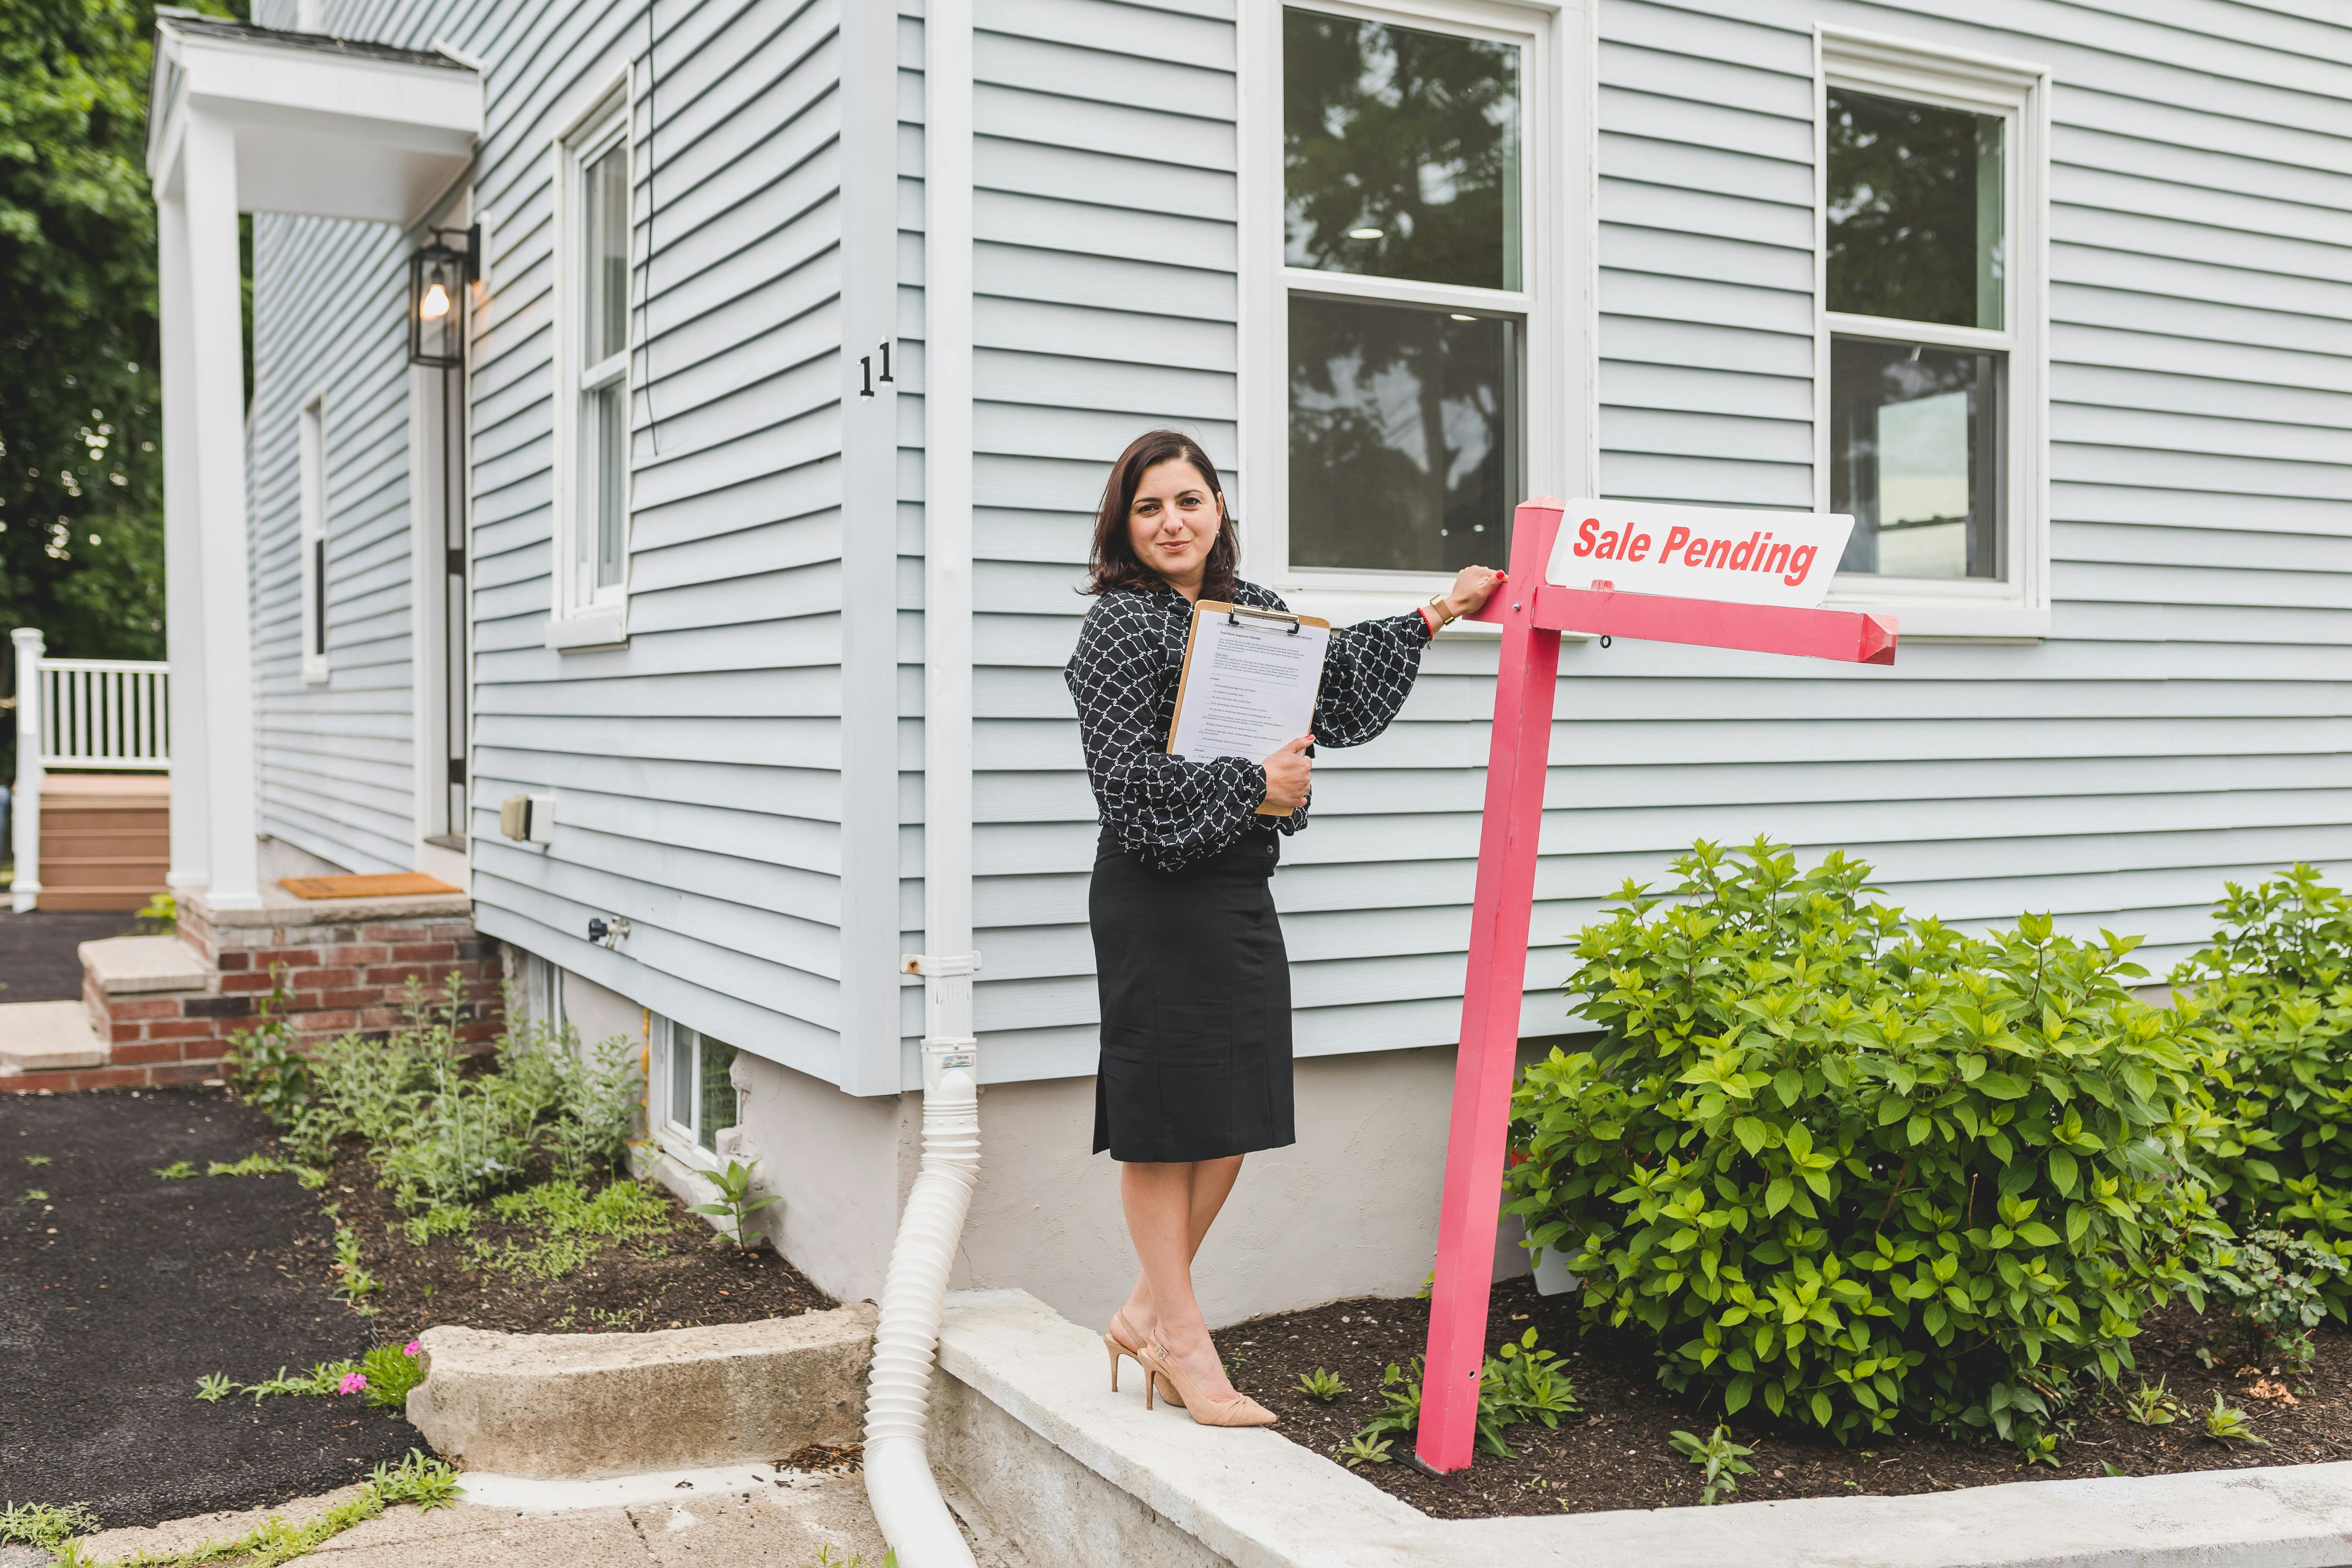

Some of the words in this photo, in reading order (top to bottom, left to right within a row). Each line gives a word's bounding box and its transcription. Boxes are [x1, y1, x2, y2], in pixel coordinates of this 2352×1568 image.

[860, 342, 893, 397] 11
[1574, 518, 1651, 562] Sale
[1658, 526, 1818, 586] Pending
